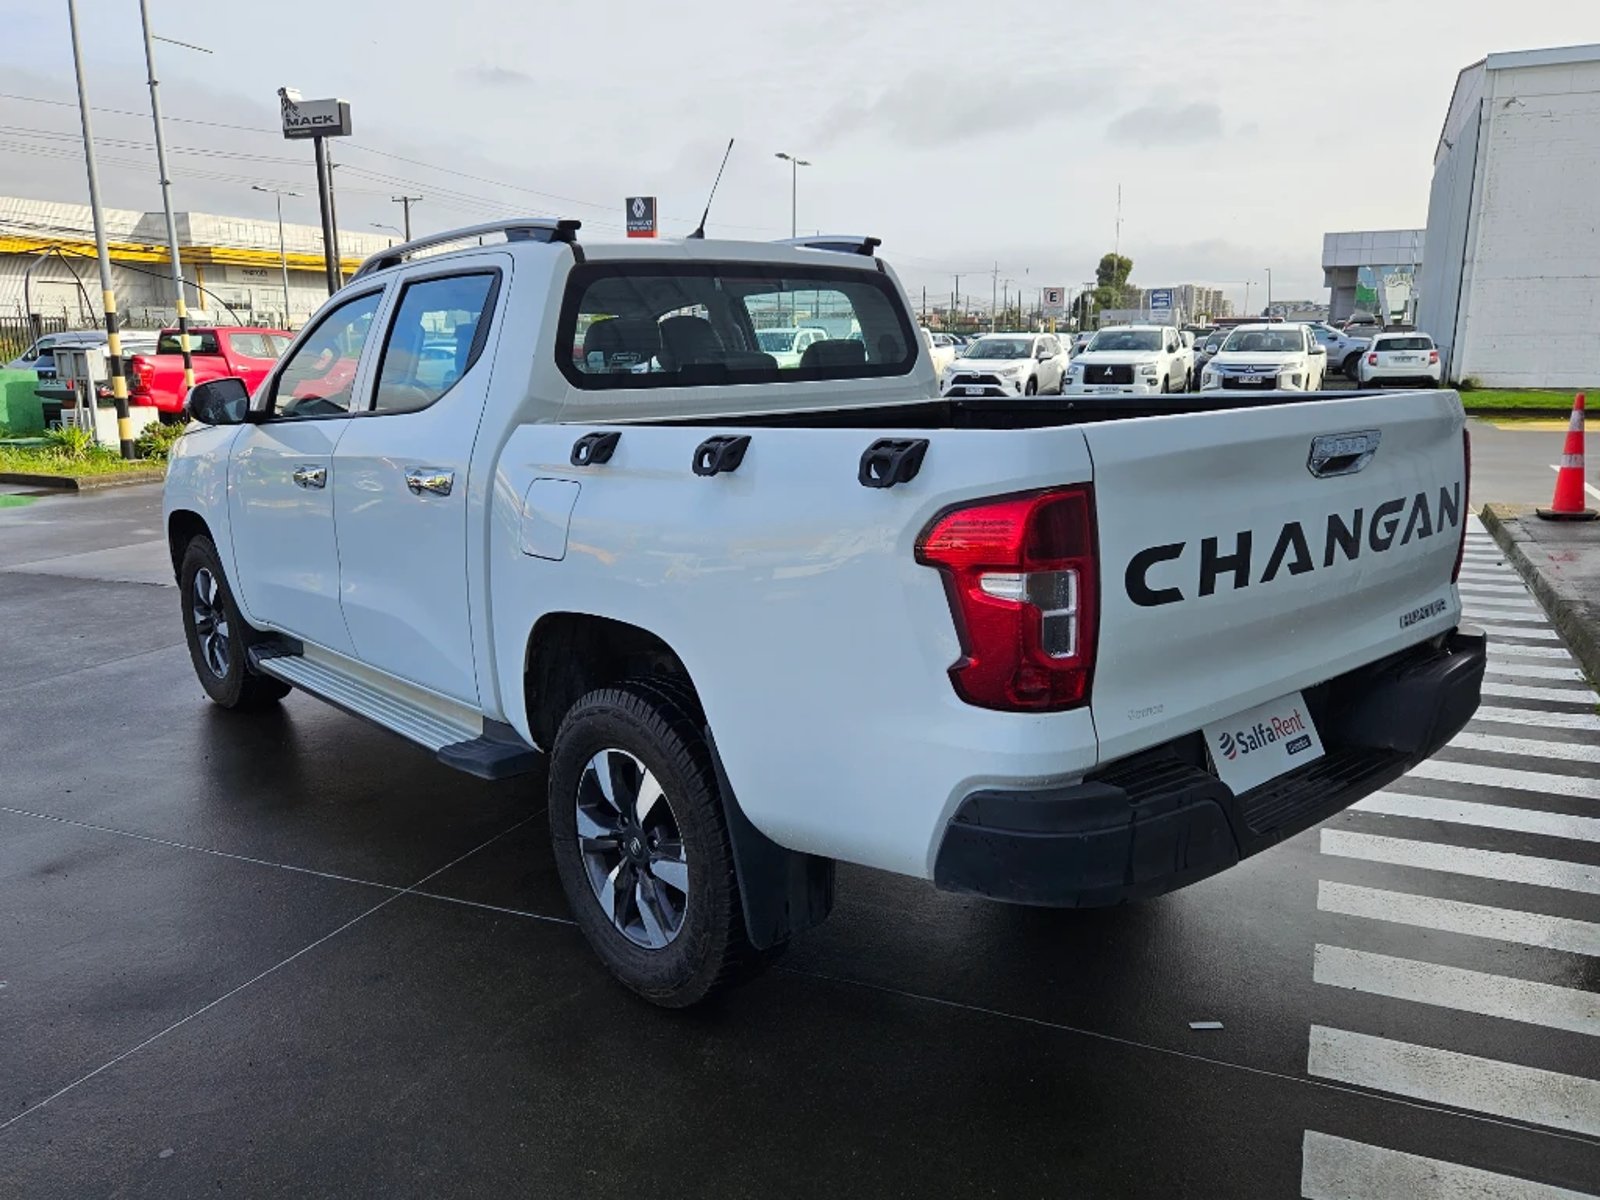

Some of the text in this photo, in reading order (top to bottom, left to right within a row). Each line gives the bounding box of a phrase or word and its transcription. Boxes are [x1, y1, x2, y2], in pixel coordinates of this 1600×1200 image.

[285, 115, 334, 127] MACK
[1049, 291, 1057, 302] E
[1125, 482, 1460, 606] CHANGAN
[1235, 708, 1306, 754] SalfaRent
